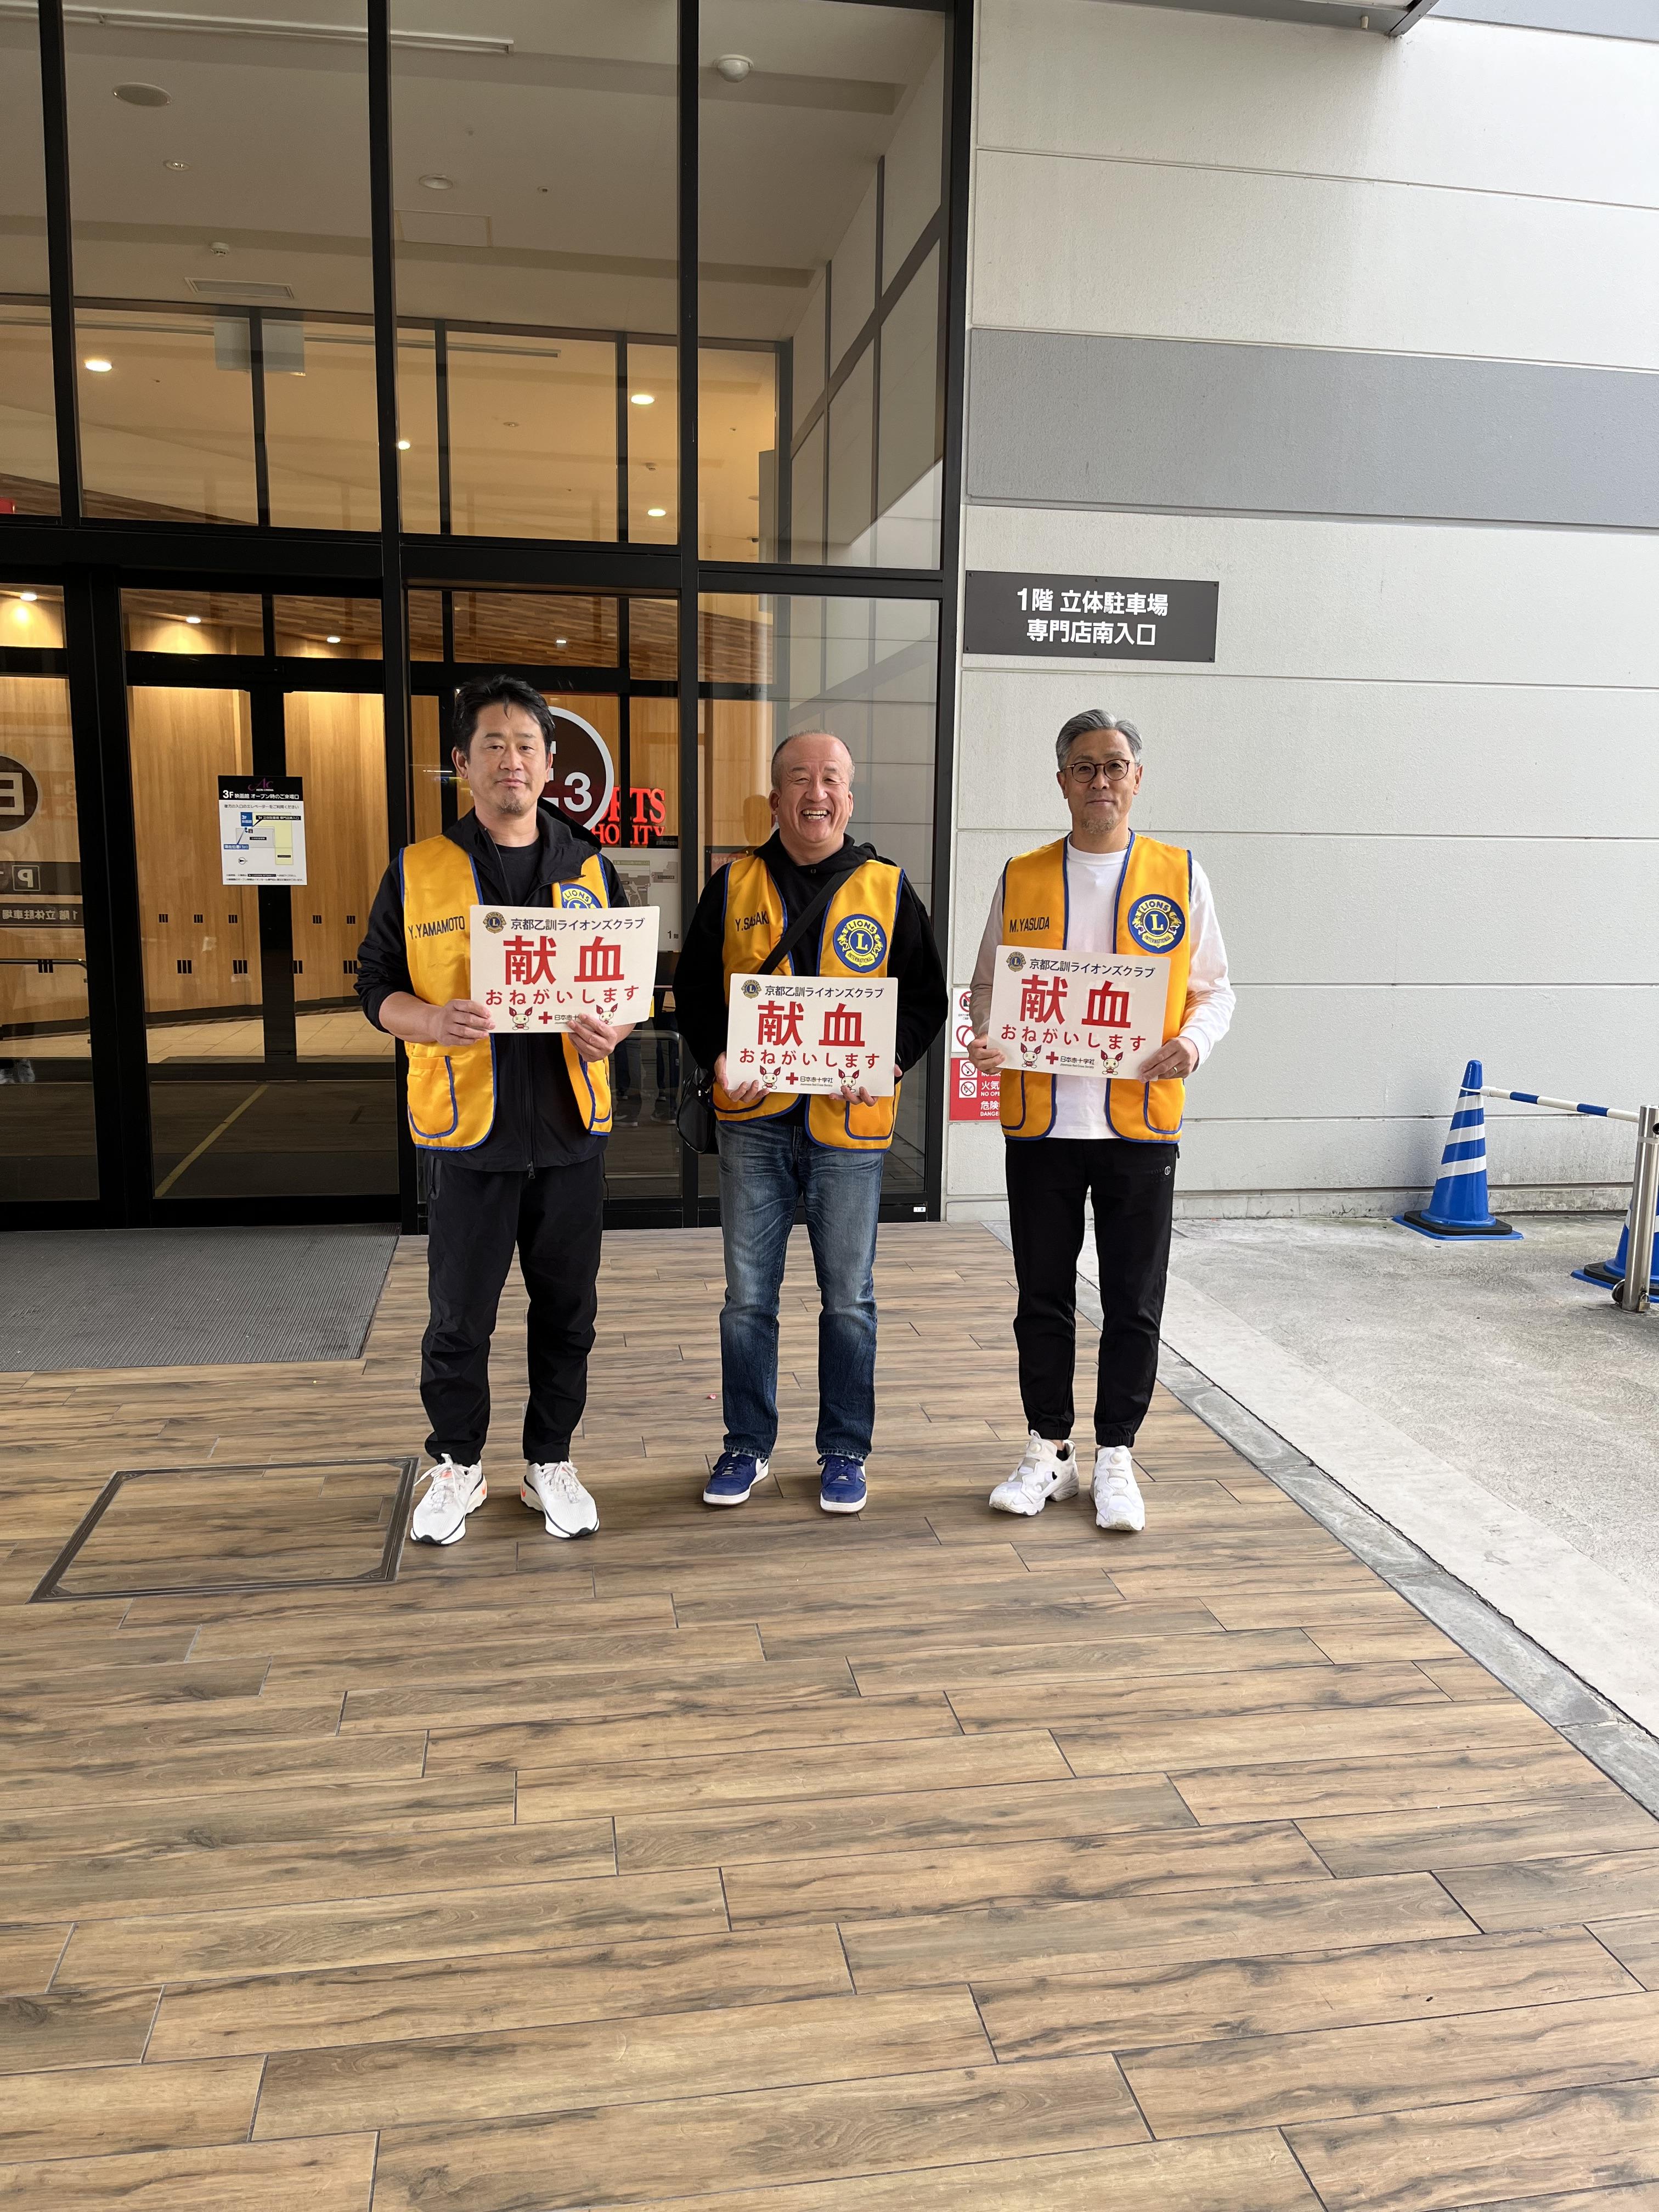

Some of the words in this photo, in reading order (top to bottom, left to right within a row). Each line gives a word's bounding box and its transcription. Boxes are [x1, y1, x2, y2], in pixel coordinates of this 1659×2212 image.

[1017, 588, 1053, 611] 1階
[1060, 590, 1169, 617] 立体駐車場
[1026, 618, 1156, 646] 専門店南入口
[223, 790, 234, 798] 3F
[565, 890, 589, 902] LIONS
[1141, 901, 1169, 911] LIONS
[408, 916, 465, 940] Y.YAMAMOTO
[511, 917, 645, 931] 京都乙訓ライオンズクラブ
[848, 921, 876, 933] LIONS
[1009, 916, 1049, 933] M.YASUDA
[503, 935, 624, 985] 献血
[1029, 958, 1155, 978] 京都乙訓ライオンズクラブ
[486, 985, 639, 1006] おねがいします
[765, 986, 884, 998] 京都乙訓ライオンズクラブ
[1019, 974, 1131, 1029] 献血
[757, 1000, 865, 1047] 献血
[1001, 1024, 1146, 1052] おねがいします
[739, 1048, 880, 1068] おねがいします
[981, 1080, 1000, 1091] 火気
[980, 1101, 1000, 1110] 危険
